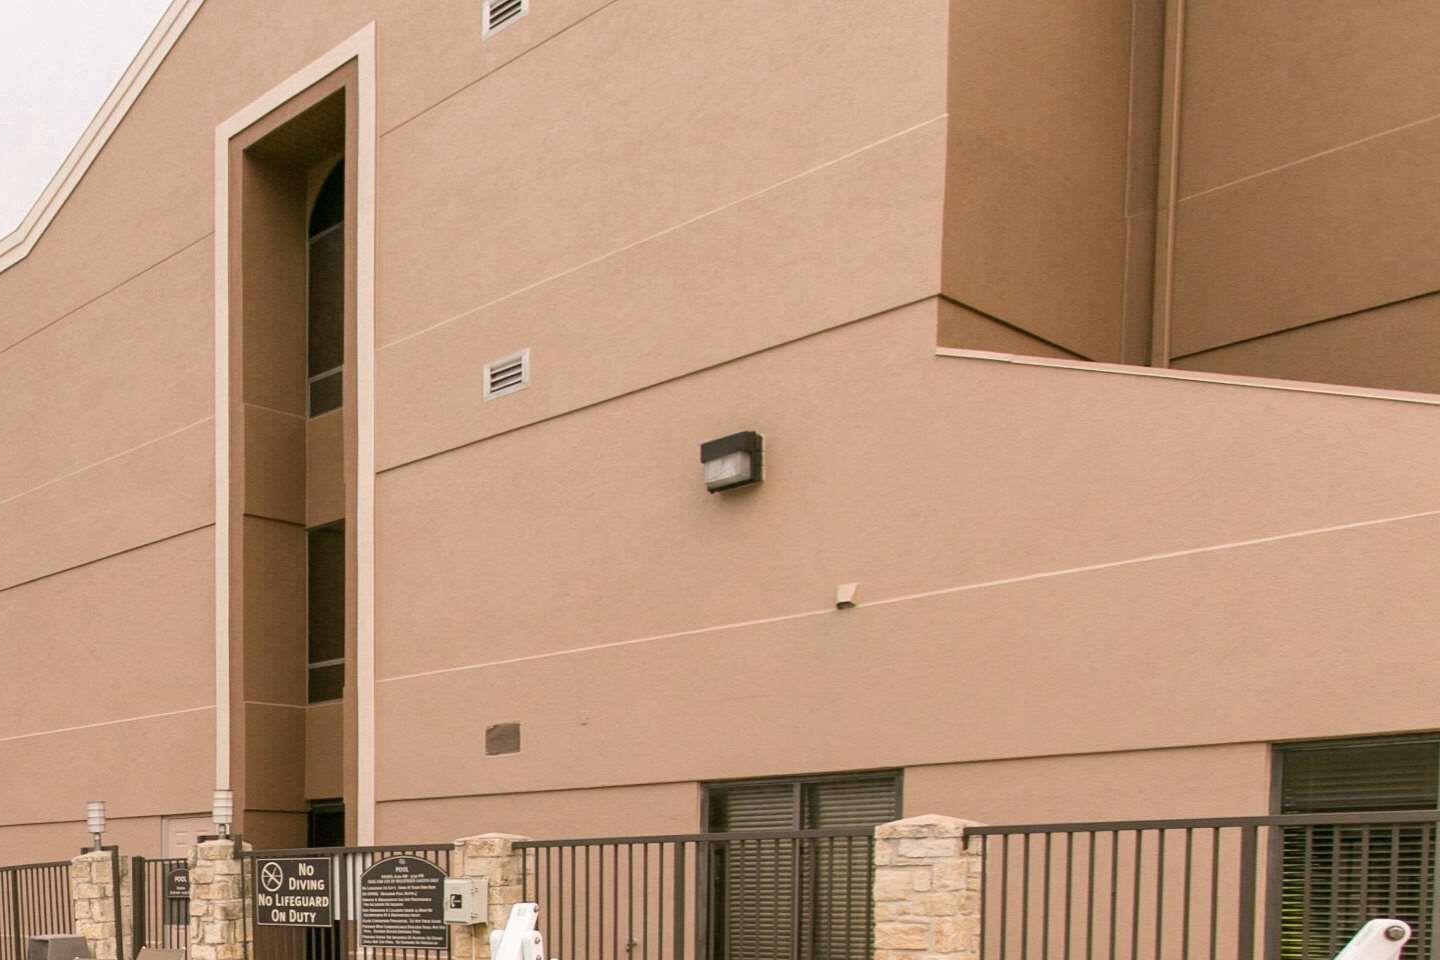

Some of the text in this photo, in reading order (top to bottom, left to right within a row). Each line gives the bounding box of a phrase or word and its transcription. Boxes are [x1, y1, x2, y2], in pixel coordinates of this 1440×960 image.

[298, 863, 314, 876] NO
[288, 877, 325, 890] DIVING
[258, 893, 329, 907] NO LIFEGUARD
[271, 909, 316, 922] ON DUTY
